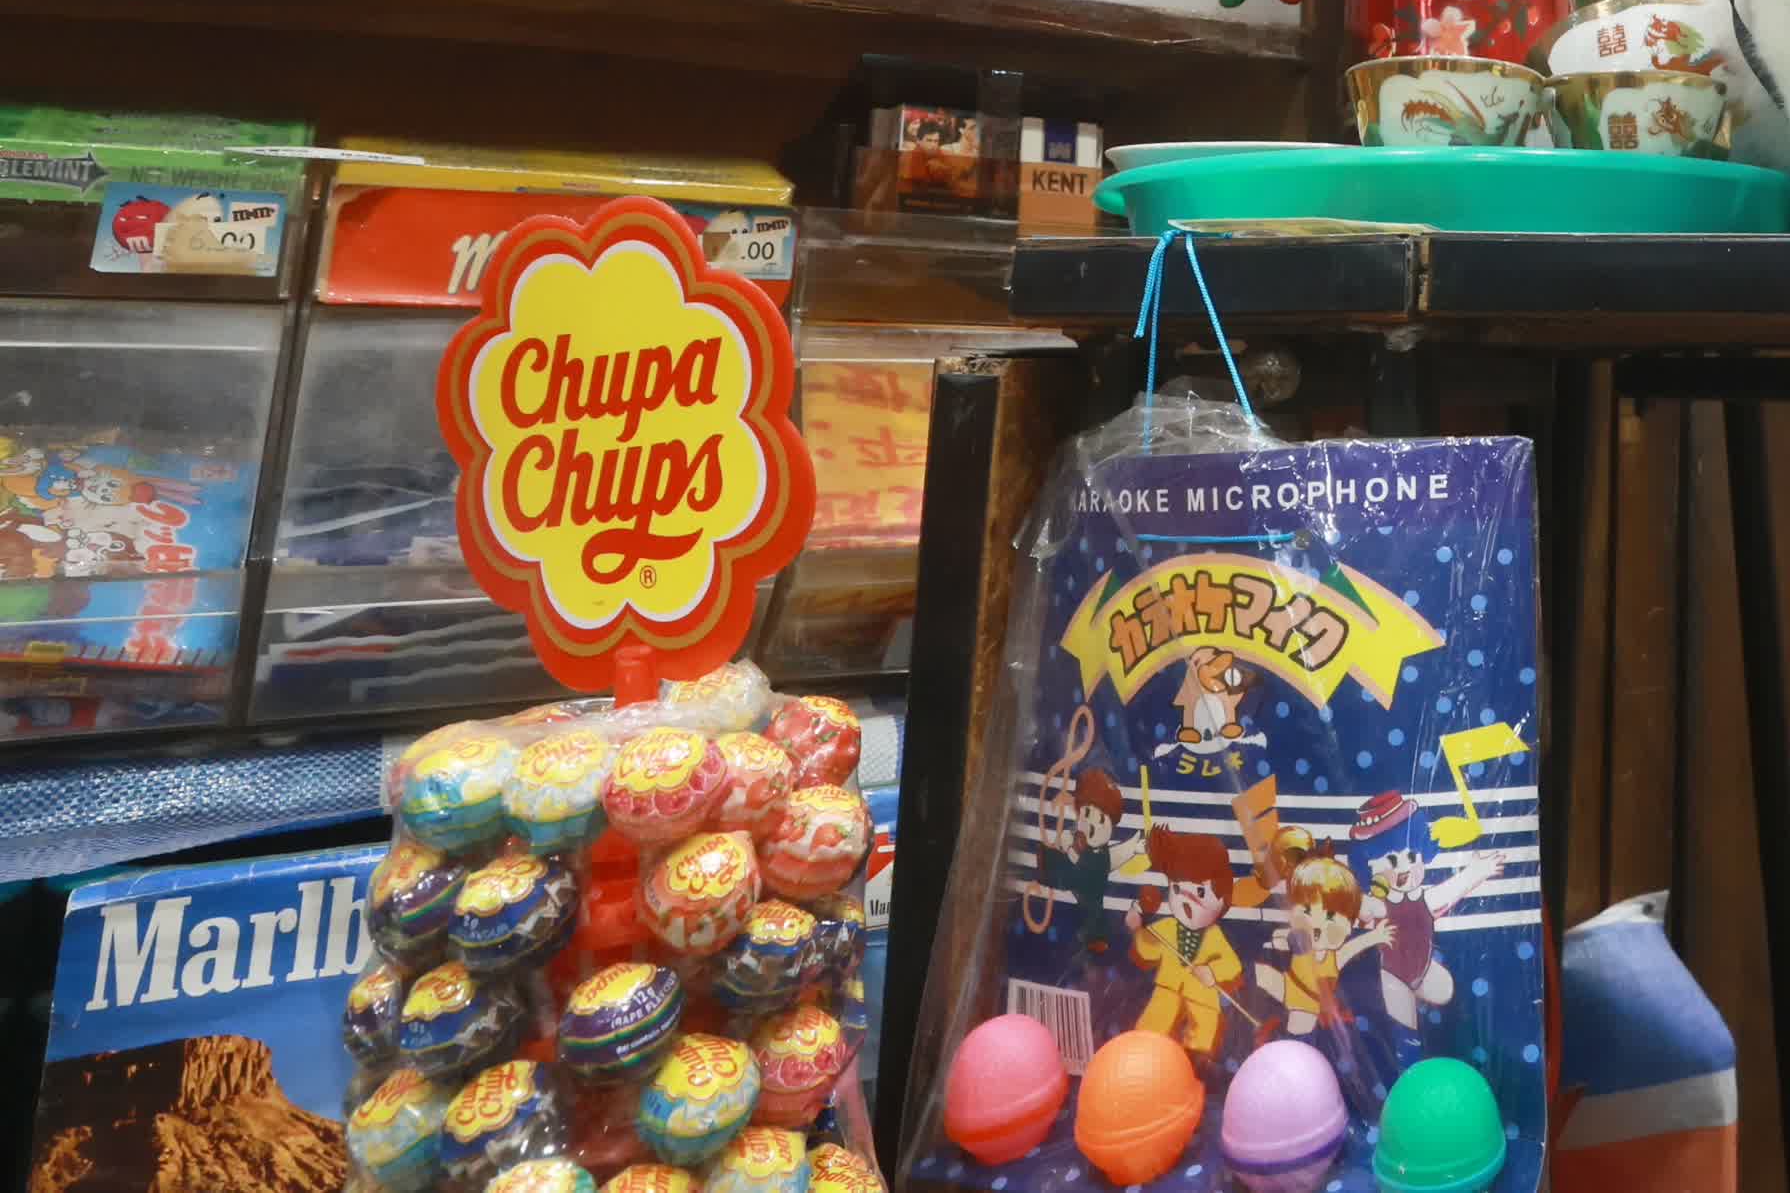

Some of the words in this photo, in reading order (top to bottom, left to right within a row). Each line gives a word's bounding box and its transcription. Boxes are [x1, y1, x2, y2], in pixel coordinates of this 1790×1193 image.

[1032, 169, 1088, 195] KENT
[501, 334, 722, 443] Chupa
[502, 428, 724, 585] Chups
[1187, 474, 1450, 513] MICROPHONE
[1109, 569, 1350, 678] カラオケマイク
[1175, 752, 1245, 778] ラムネ
